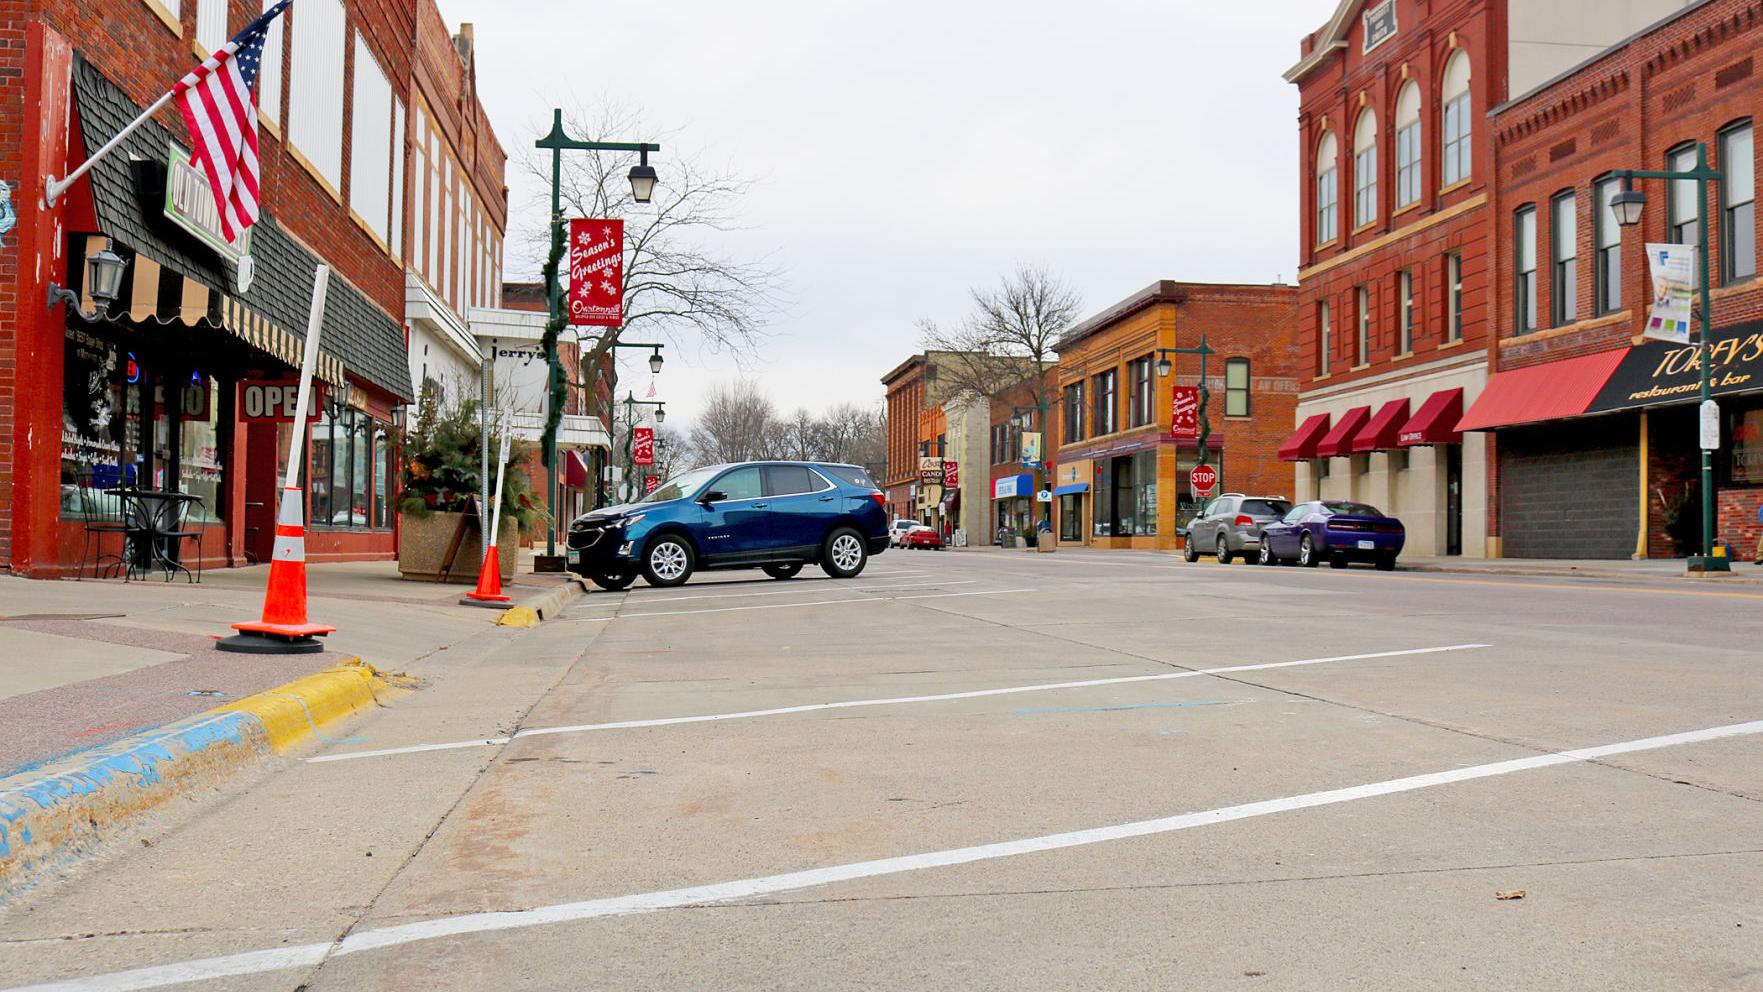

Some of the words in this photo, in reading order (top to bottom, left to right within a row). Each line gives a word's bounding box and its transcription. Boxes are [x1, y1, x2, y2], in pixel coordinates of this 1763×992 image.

[173, 163, 191, 213] OLD
[572, 235, 615, 266] Season's
[572, 252, 621, 281] Greetings
[491, 338, 546, 366] jerry's
[1628, 380, 1703, 400] restaurant
[1720, 371, 1752, 387] bar
[1192, 473, 1215, 483] STOP
